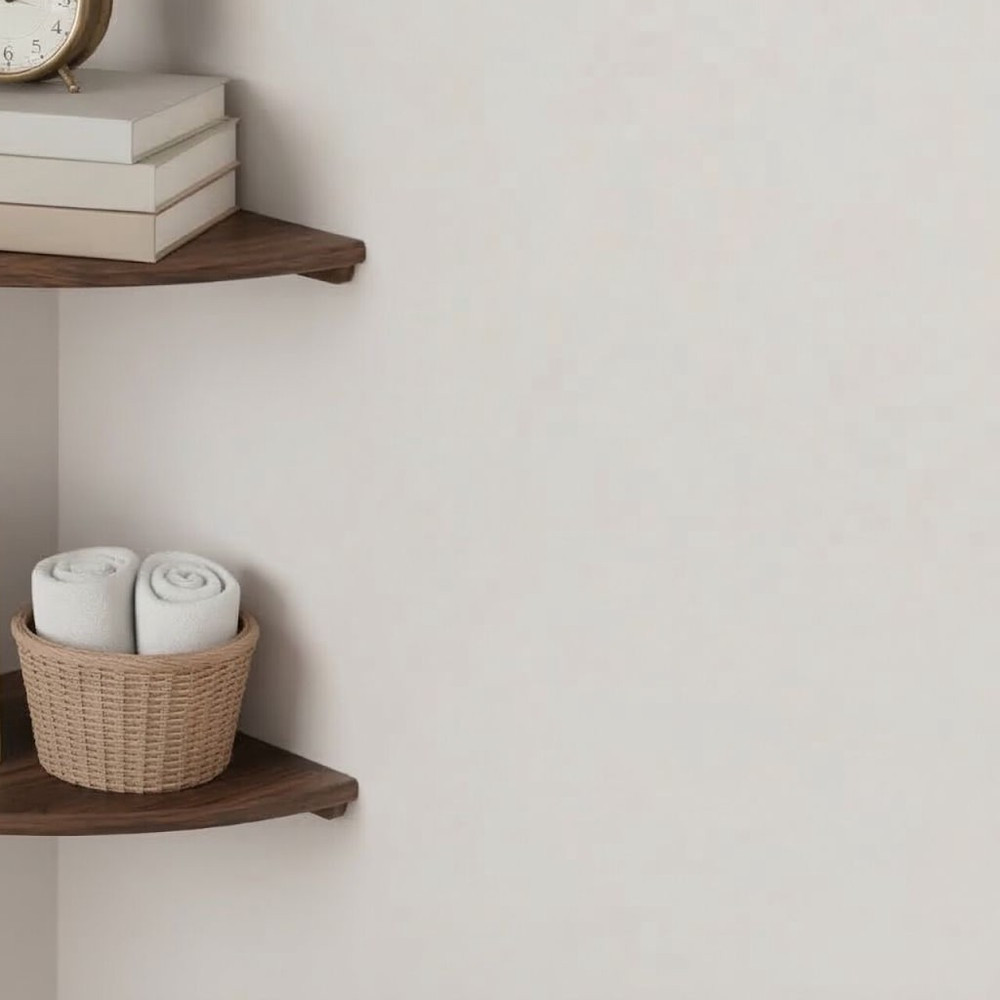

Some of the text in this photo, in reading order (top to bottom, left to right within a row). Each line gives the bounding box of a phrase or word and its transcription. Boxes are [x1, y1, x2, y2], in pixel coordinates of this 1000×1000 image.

[51, 20, 62, 34] 4
[3, 46, 13, 61] 6
[32, 39, 41, 54] 5
